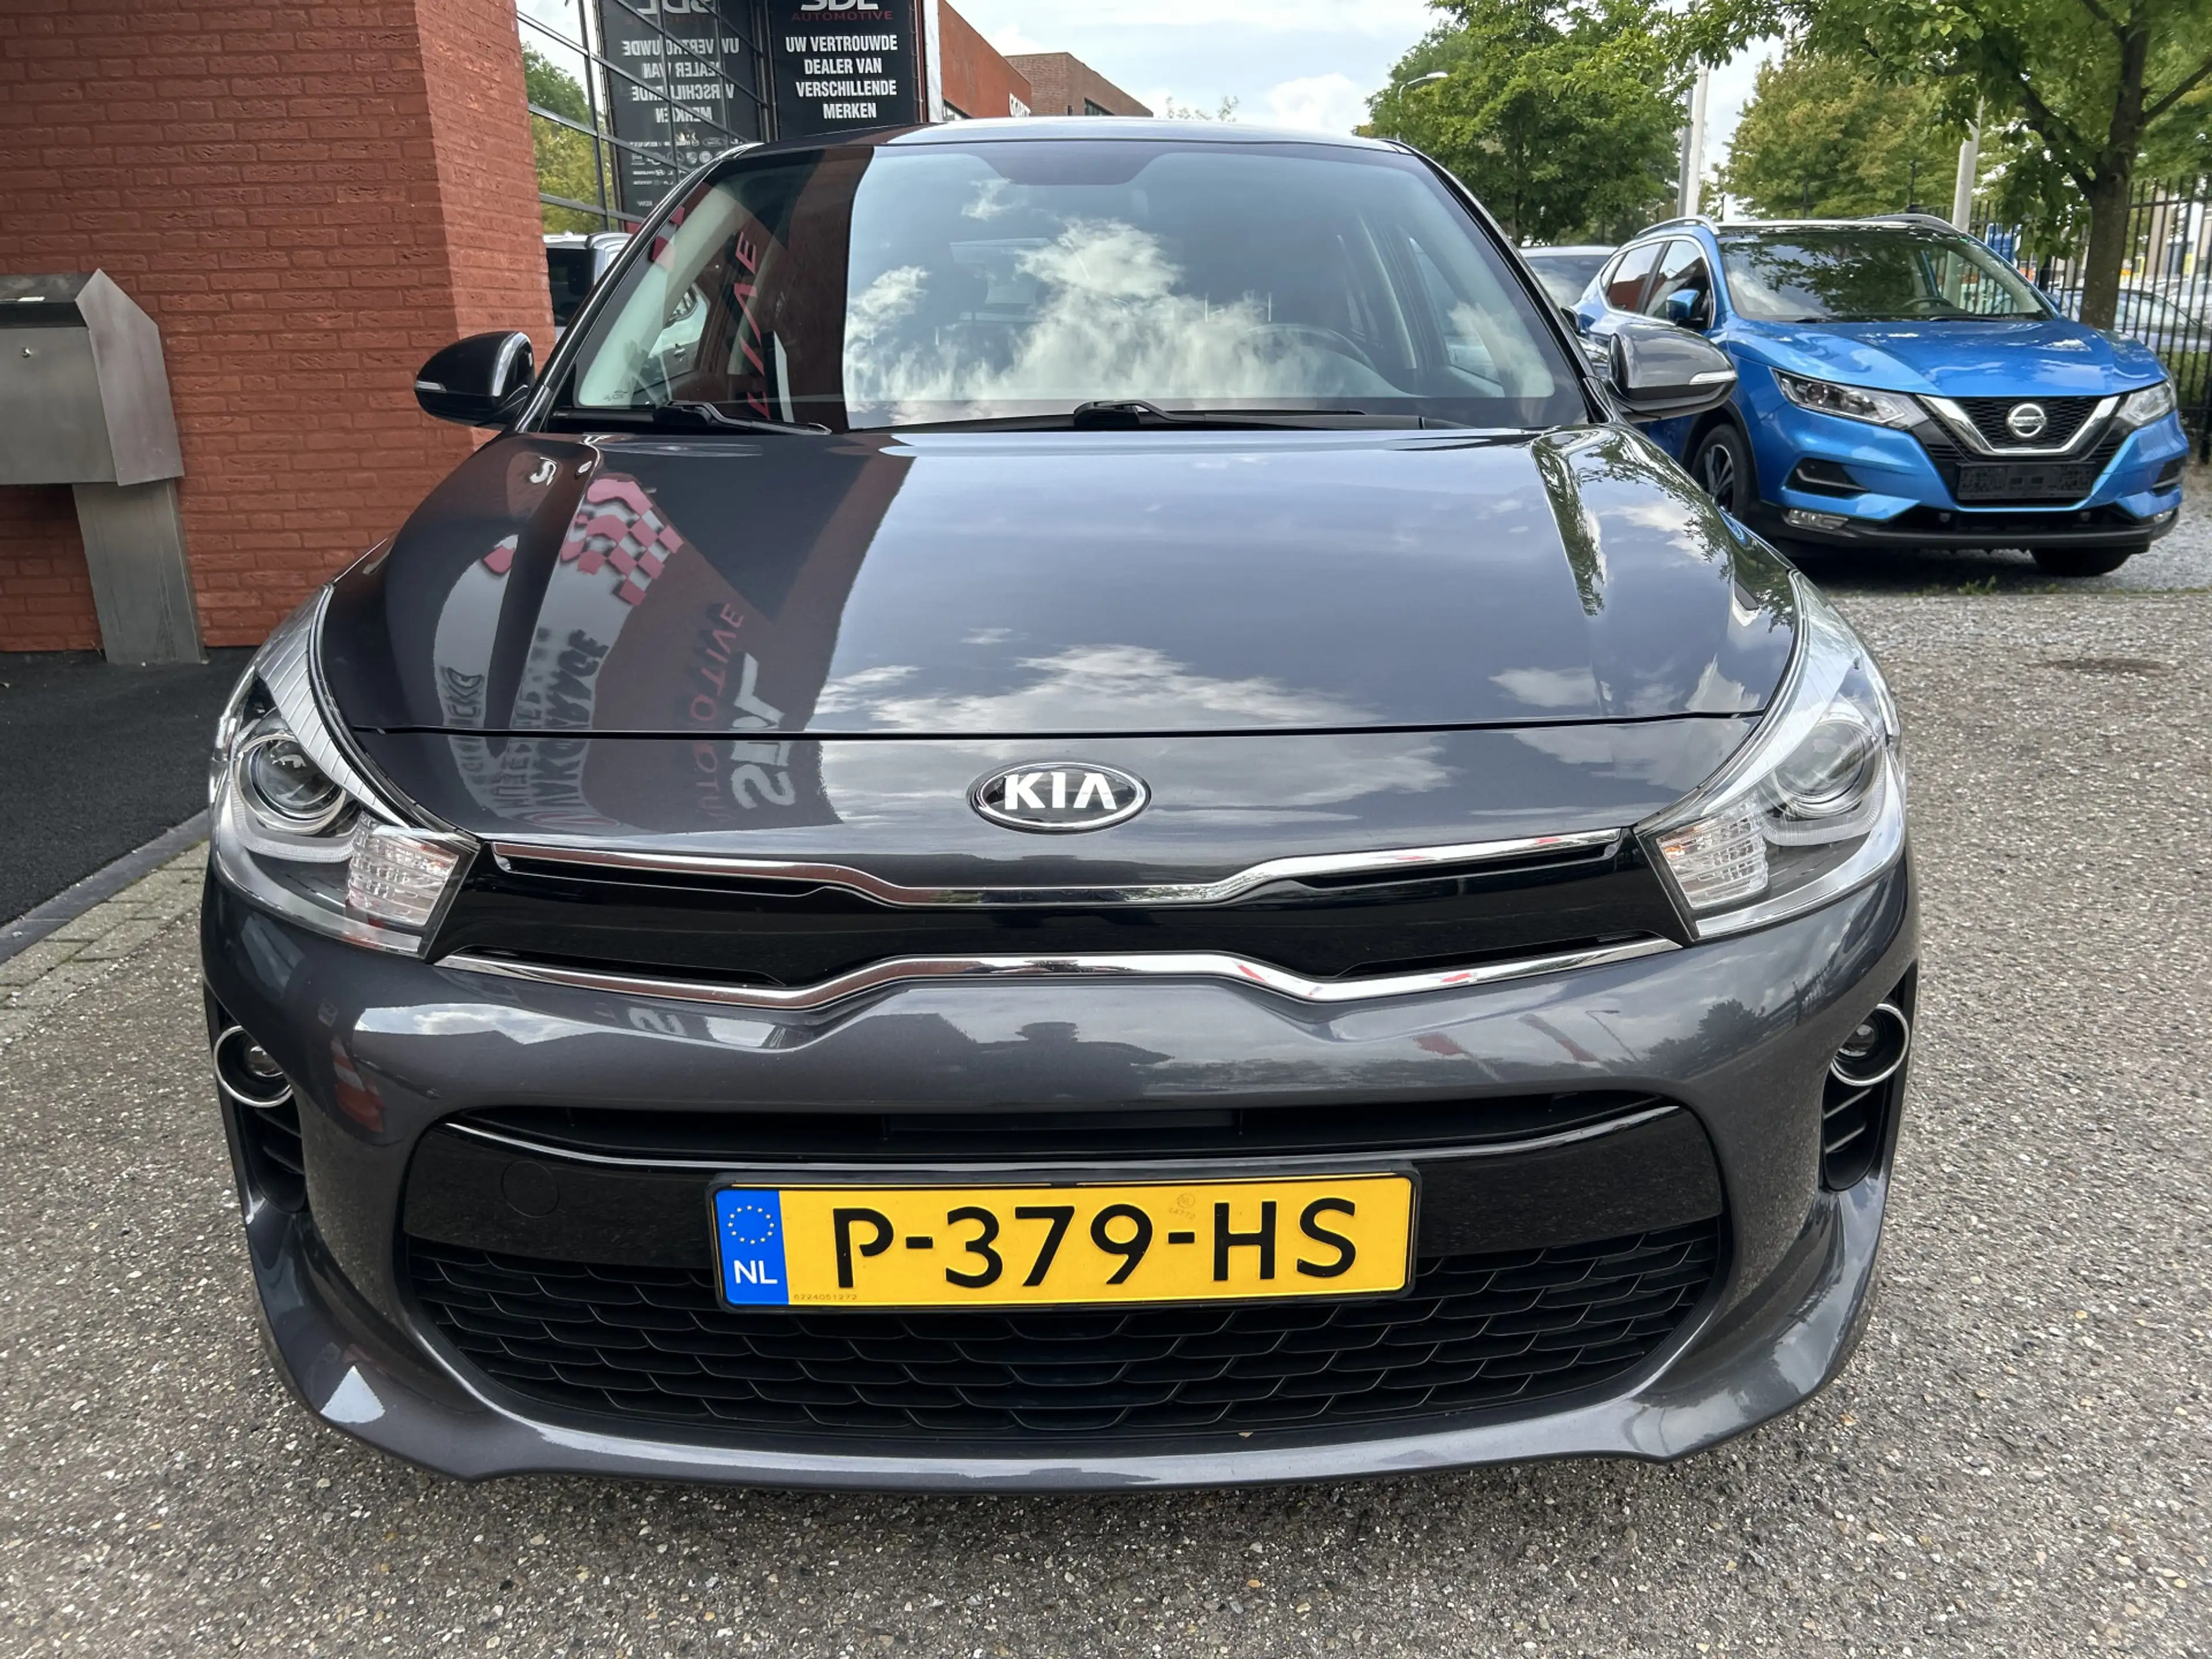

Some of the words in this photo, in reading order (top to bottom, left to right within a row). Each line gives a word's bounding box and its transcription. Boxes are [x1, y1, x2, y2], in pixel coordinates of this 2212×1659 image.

[791, 10, 893, 21] AUTOMOTIVE
[786, 36, 806, 52] UW
[810, 35, 897, 52] VERTROUWDE
[804, 58, 853, 75] DEALER
[856, 58, 882, 74] VAN
[796, 79, 897, 97] VERSCHILLENDE
[823, 103, 877, 119] MERKEN
[1004, 772, 1117, 809] KIA
[832, 1198, 1358, 1289] P-379-HS
[733, 1260, 778, 1284] NL
